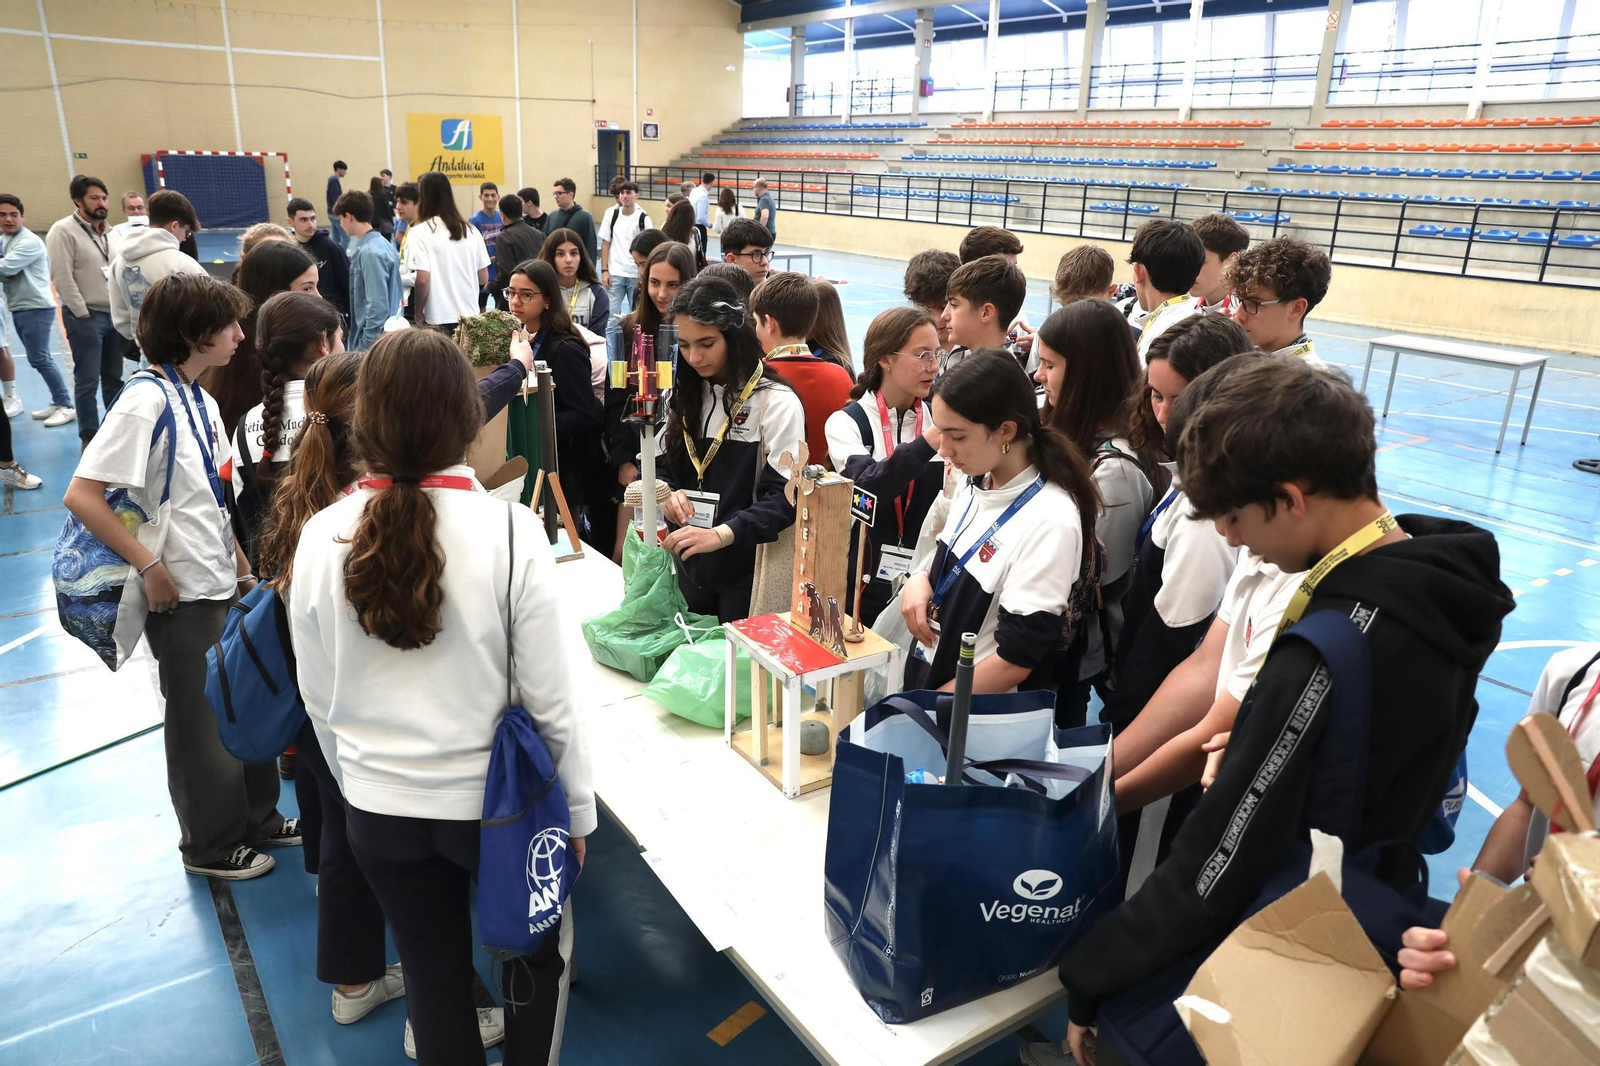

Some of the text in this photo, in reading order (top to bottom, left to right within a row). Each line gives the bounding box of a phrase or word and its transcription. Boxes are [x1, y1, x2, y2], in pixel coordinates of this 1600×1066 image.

[244, 417, 305, 433] étic Mud
[1445, 800, 1461, 811] PLA
[980, 896, 1082, 923] Vegenat
